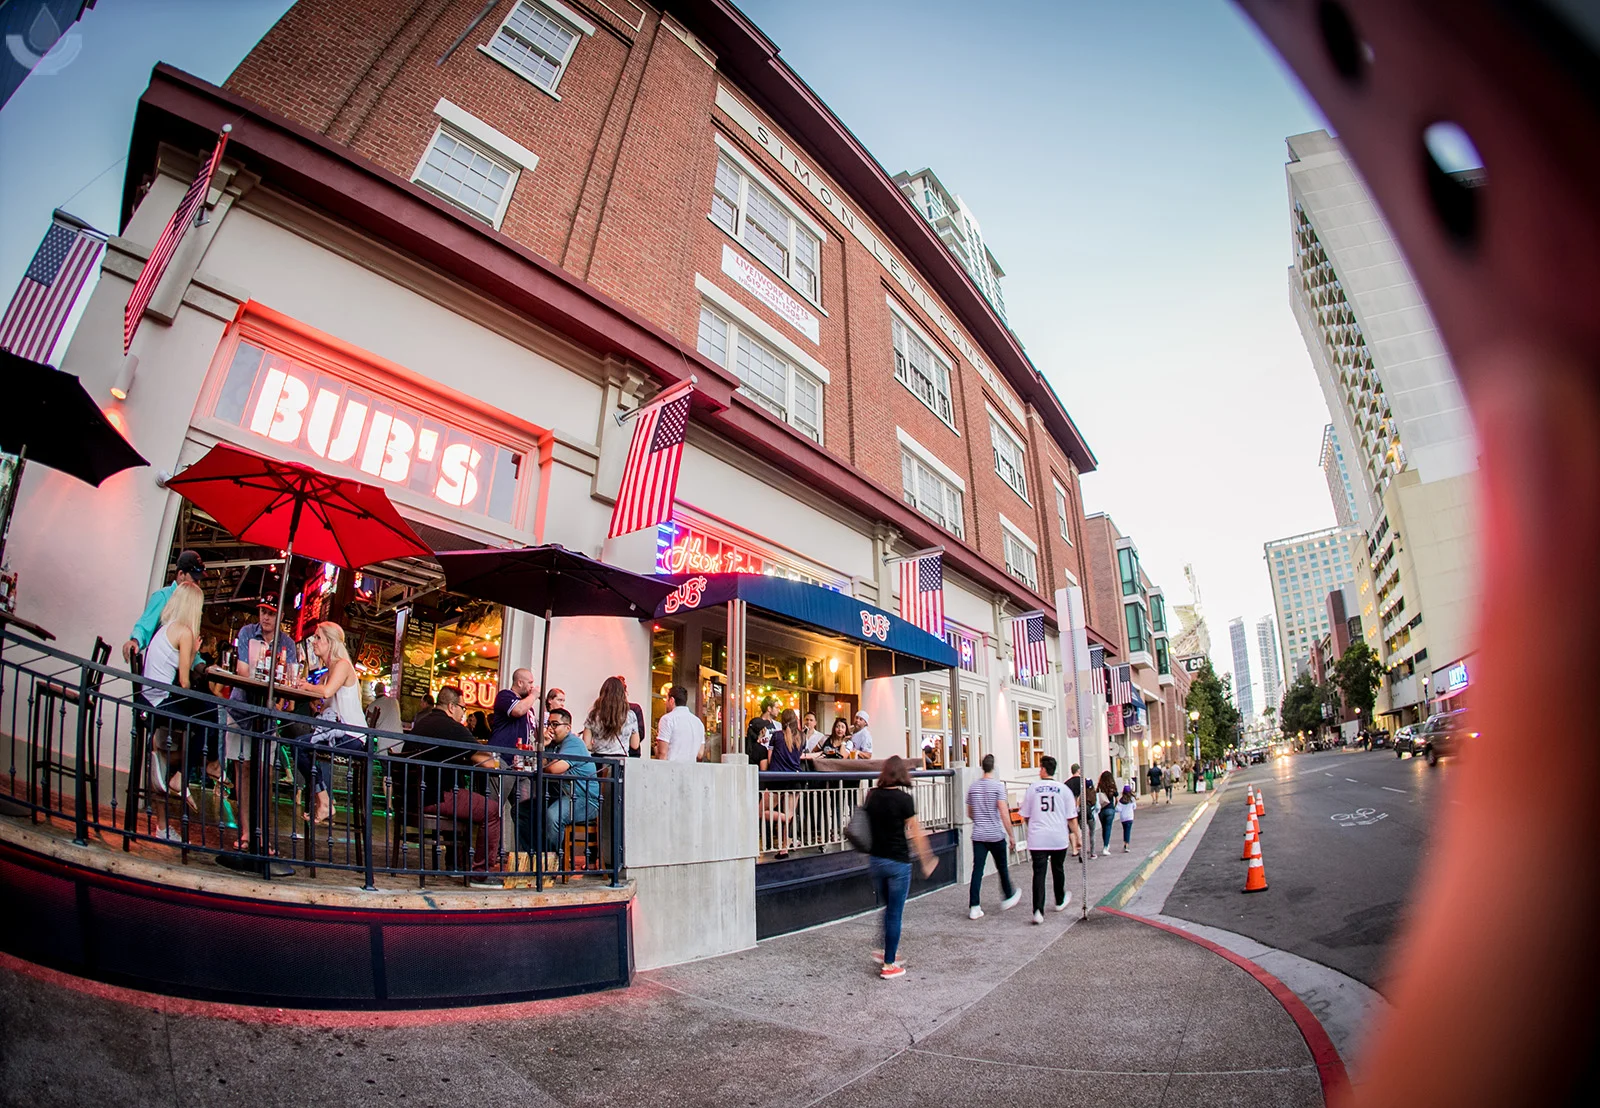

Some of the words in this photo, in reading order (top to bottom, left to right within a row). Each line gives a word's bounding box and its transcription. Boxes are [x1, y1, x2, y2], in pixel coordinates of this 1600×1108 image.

[735, 256, 784, 299] LIVE/WORK
[786, 297, 809, 320] LOFTS
[757, 126, 854, 230] SIMON
[873, 240, 926, 307] LEVI
[939, 315, 1013, 408] COMPANY
[249, 367, 482, 506] BUB'S
[1041, 795, 1055, 812] 51
